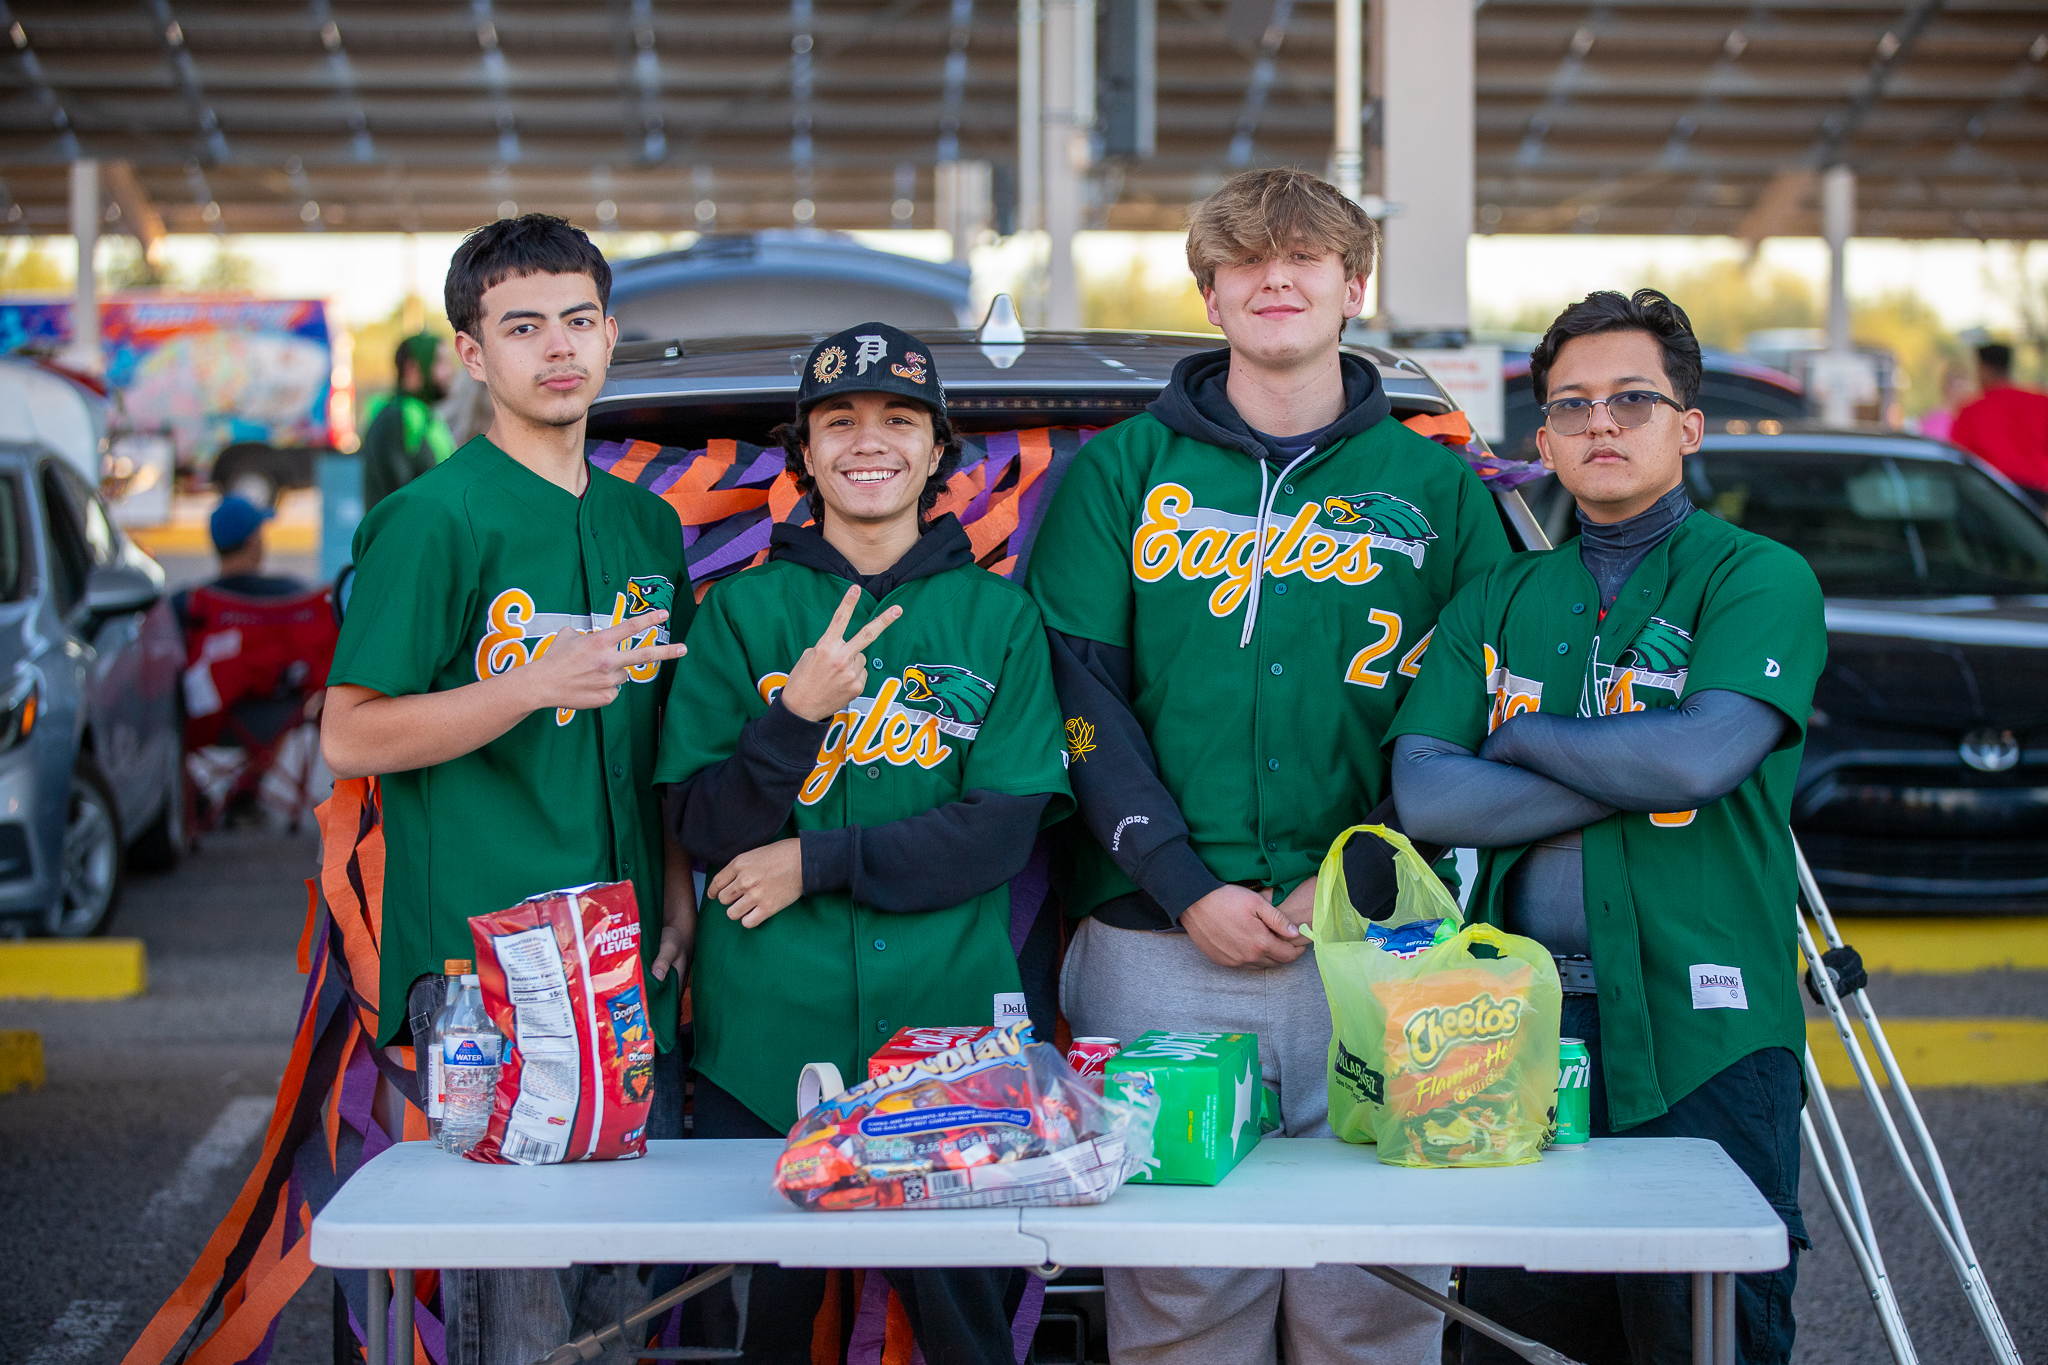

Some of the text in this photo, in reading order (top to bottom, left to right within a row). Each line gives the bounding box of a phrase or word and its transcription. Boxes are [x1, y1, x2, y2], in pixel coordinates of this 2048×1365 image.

[854, 334, 888, 377] P
[1133, 482, 1383, 618] Eagles
[1763, 657, 1782, 679] D
[1699, 974, 1739, 987] DeLONG
[1407, 997, 1518, 1065] Cheetos
[456, 1053, 483, 1062] WATER
[1484, 1037, 1515, 1070] Ho
[917, 1142, 942, 1154] 2.55
